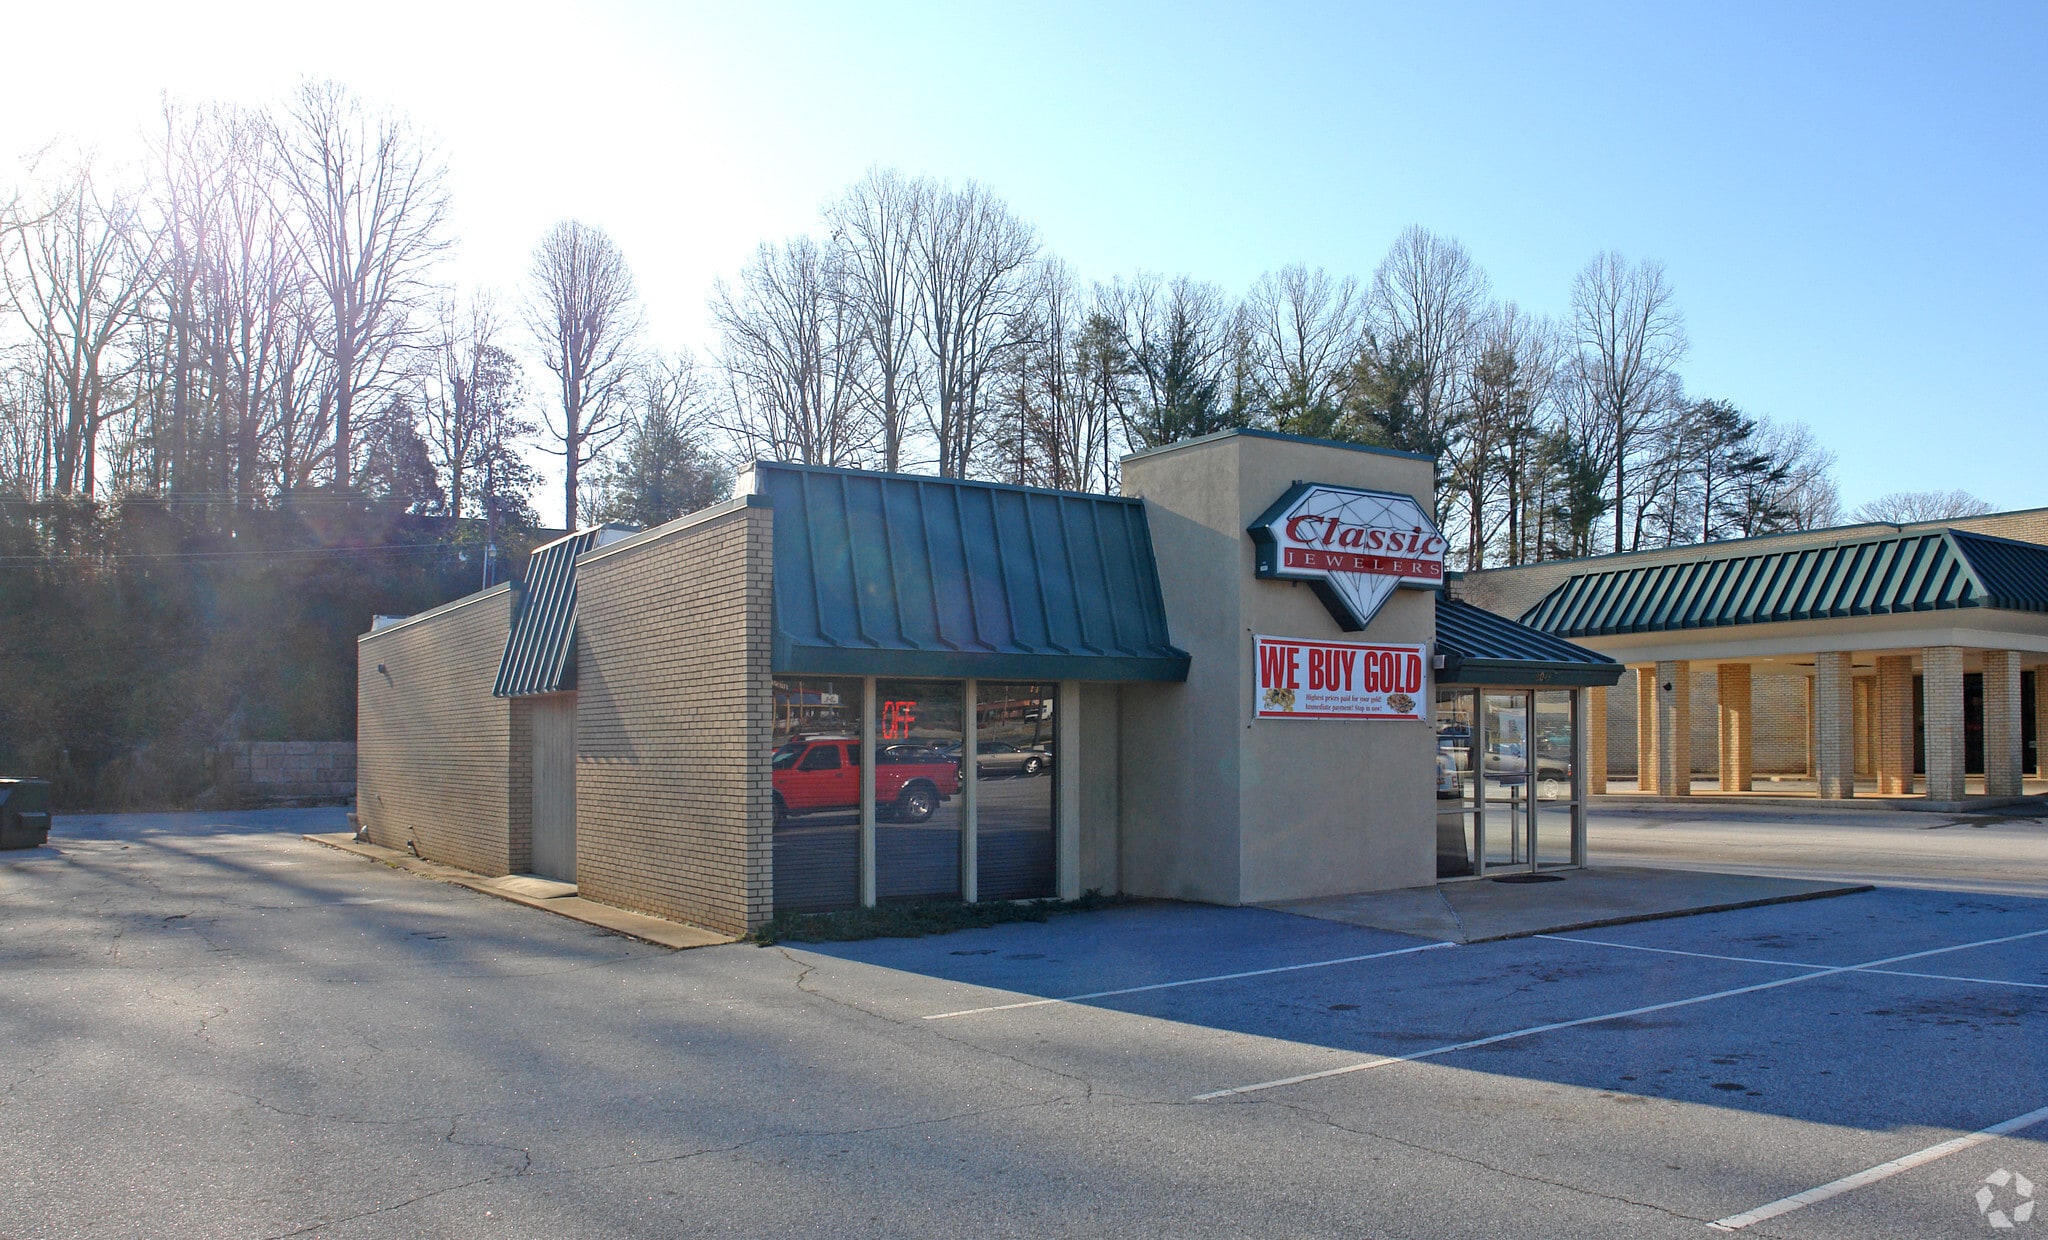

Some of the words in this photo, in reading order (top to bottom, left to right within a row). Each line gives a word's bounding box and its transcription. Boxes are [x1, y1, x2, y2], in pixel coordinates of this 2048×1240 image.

[1286, 514, 1443, 556] Classic
[1287, 552, 1440, 575] JEWELERS
[1260, 645, 1300, 689] WE
[1309, 648, 1357, 692] BUY
[1364, 651, 1422, 694] GOLD
[1306, 694, 1324, 702] Highest
[1325, 695, 1339, 703] prices
[1341, 695, 1351, 703] paid
[1306, 703, 1331, 711] Immediate
